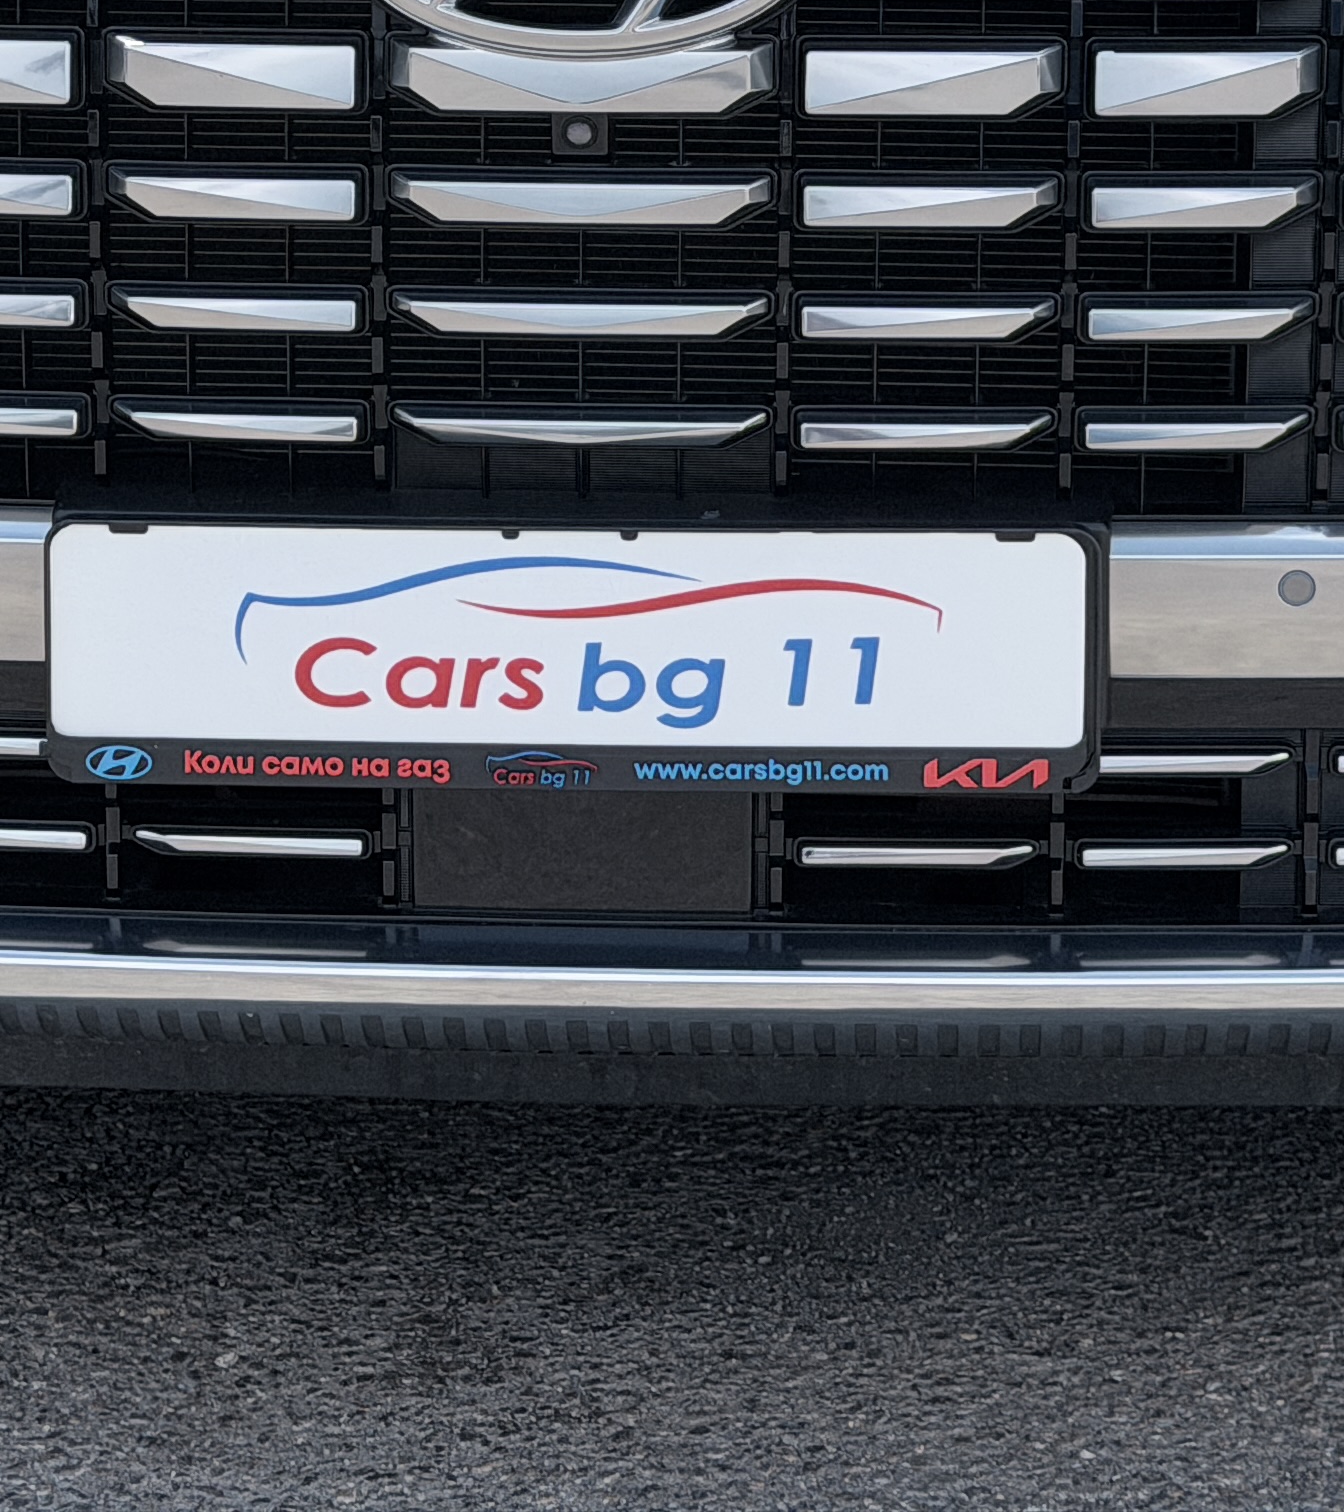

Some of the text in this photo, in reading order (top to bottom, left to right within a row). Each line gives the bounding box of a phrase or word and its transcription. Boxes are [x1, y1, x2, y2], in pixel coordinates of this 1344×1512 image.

[294, 636, 881, 730] Cars bg 11
[183, 749, 452, 785] Коли само на газ
[493, 768, 591, 789] Cars bg 11
[633, 757, 890, 786] www.carsbg11.com
[923, 757, 1050, 789] KIA
